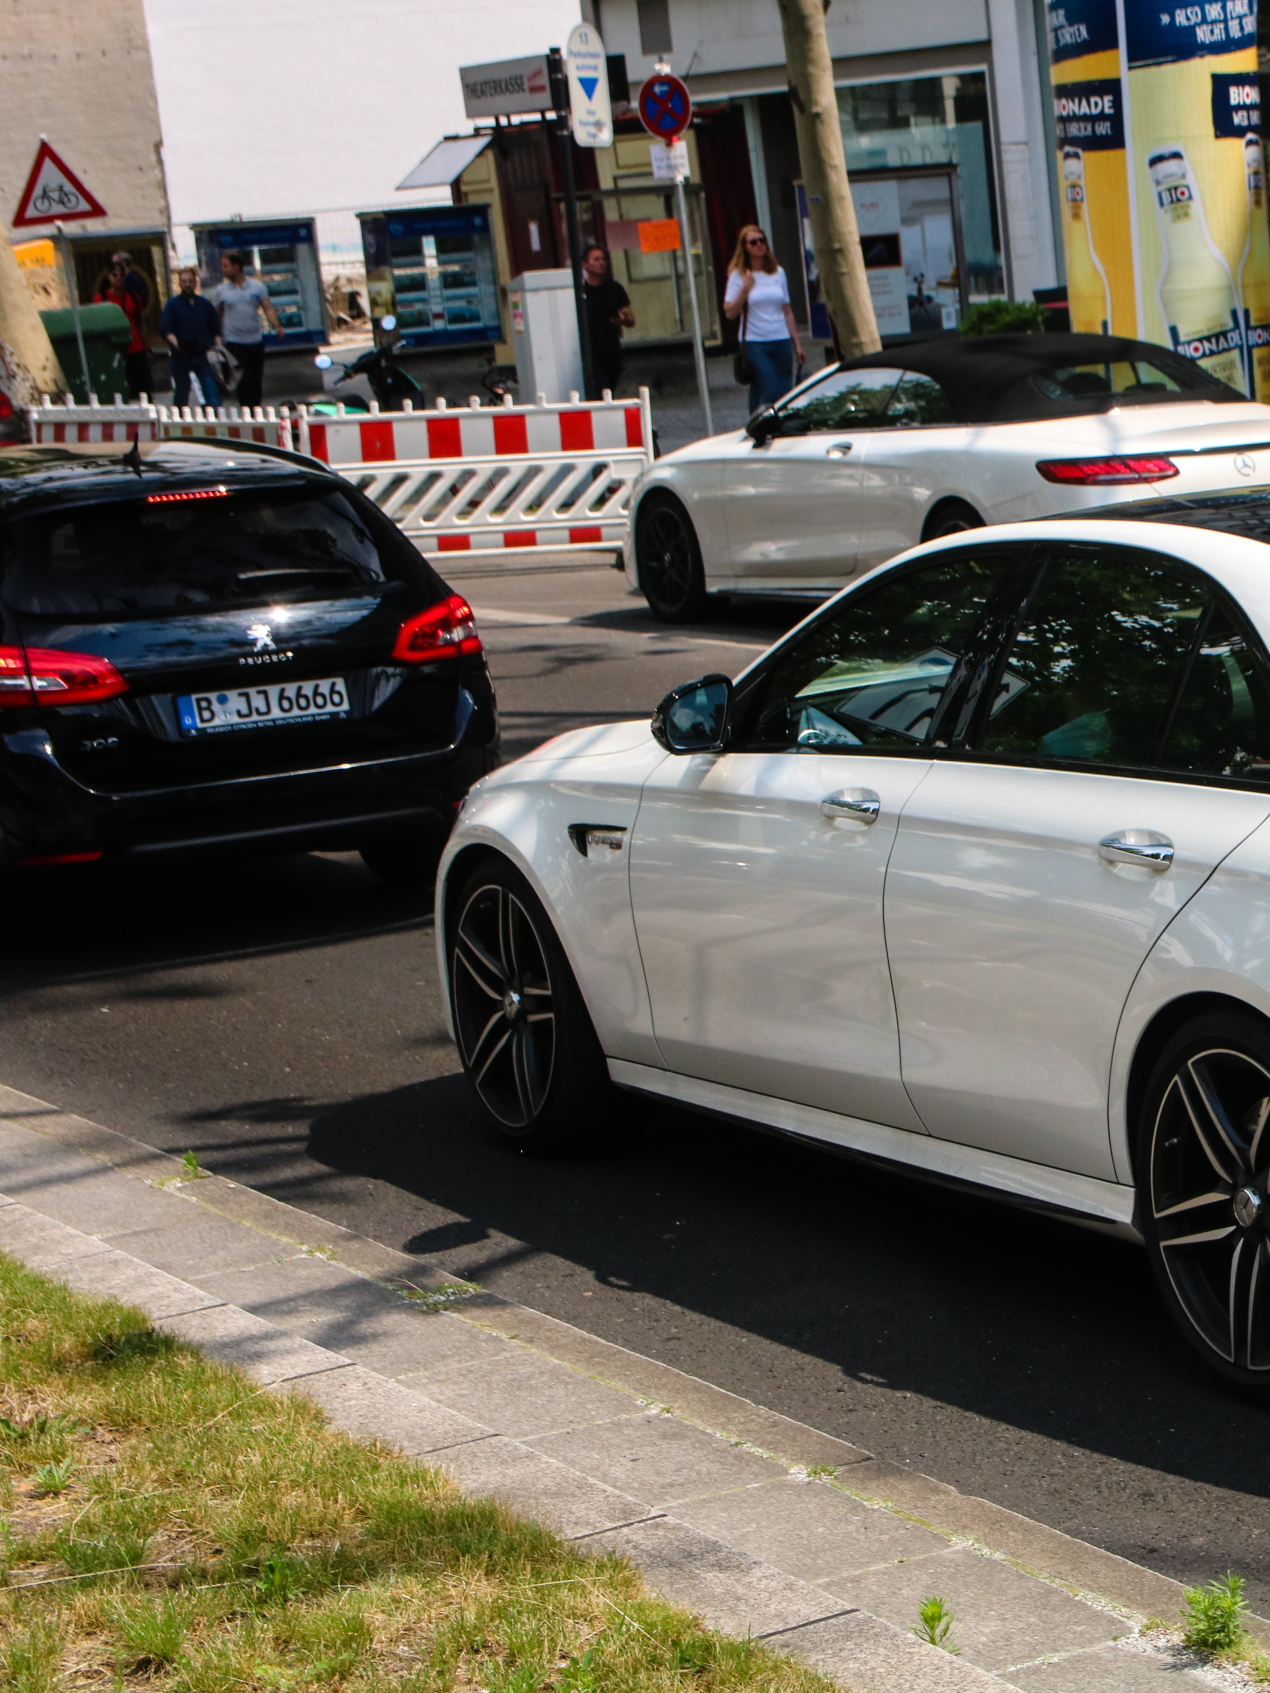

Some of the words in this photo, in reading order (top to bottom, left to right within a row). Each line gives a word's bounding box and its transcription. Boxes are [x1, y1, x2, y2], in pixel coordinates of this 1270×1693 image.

[1175, 5, 1202, 27] ALSO
[1205, 1, 1224, 22] DAS
[1195, 22, 1225, 44] NICHT
[464, 74, 526, 101] THEATERKASSE
[1161, 185, 1190, 206] BIO
[238, 651, 294, 665] PEUGEOT
[195, 697, 216, 724] B
[236, 690, 271, 719] JJ
[278, 681, 344, 713] 6666
